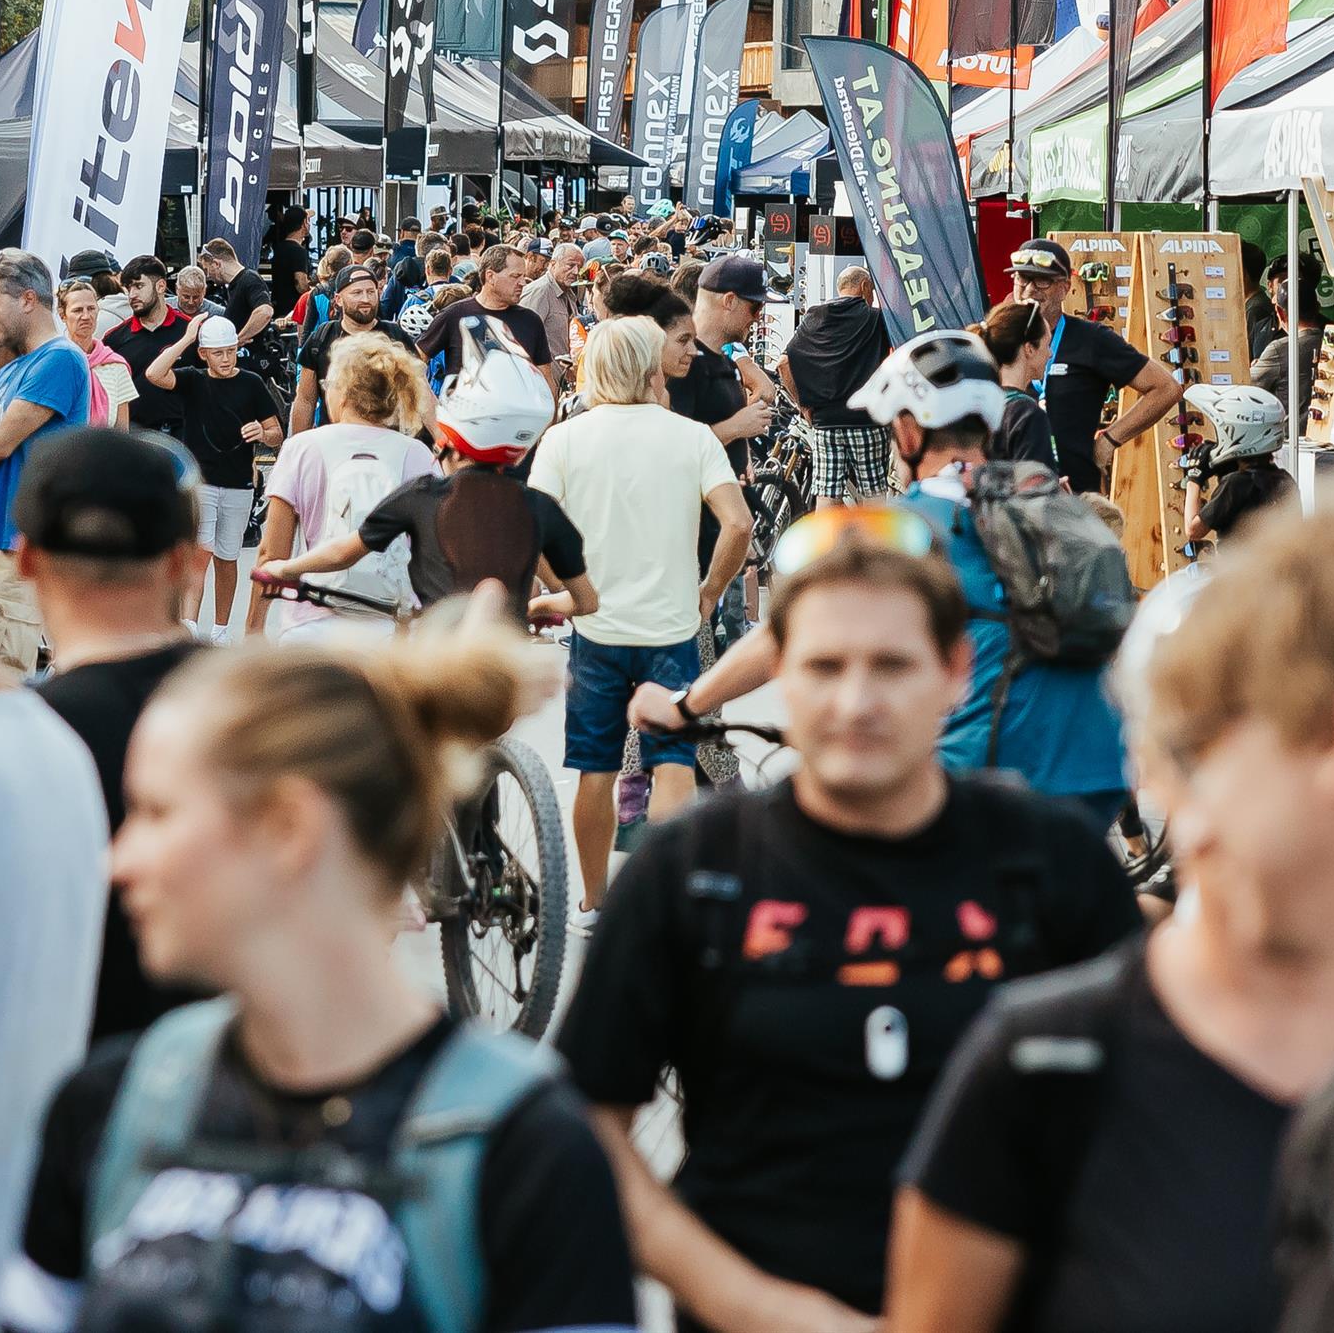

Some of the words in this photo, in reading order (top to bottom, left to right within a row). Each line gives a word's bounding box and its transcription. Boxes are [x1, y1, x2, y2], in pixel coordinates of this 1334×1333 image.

[597, 67, 616, 133] FIRST
[248, 62, 270, 185] CYCLES
[1069, 238, 1127, 253] ALPINA
[1159, 239, 1225, 254] ALPINA
